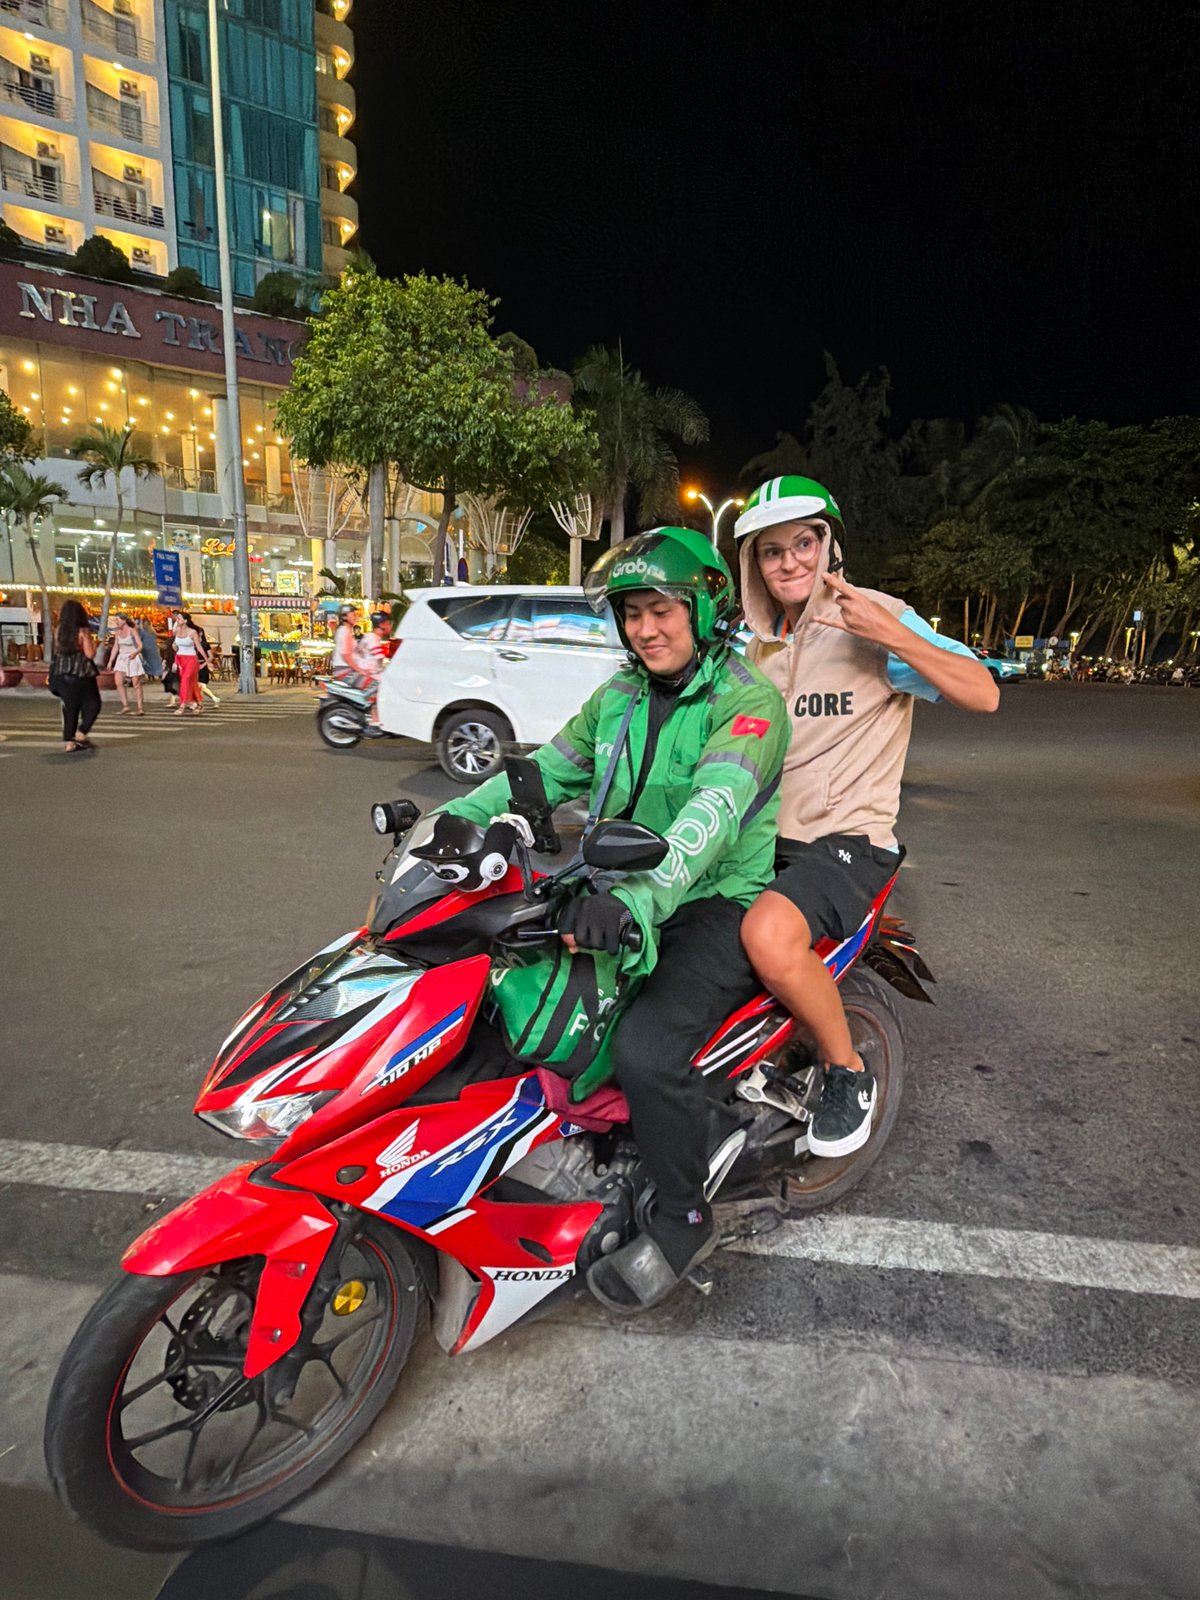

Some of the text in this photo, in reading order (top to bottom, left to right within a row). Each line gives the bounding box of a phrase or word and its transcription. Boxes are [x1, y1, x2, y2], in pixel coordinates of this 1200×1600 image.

[17, 281, 298, 366] NHA TRAN
[612, 557, 647, 578] Grab
[794, 692, 853, 717] CORE
[413, 1037, 441, 1066] HP
[379, 1149, 430, 1179] HONDA
[492, 1269, 574, 1282] HONDA
